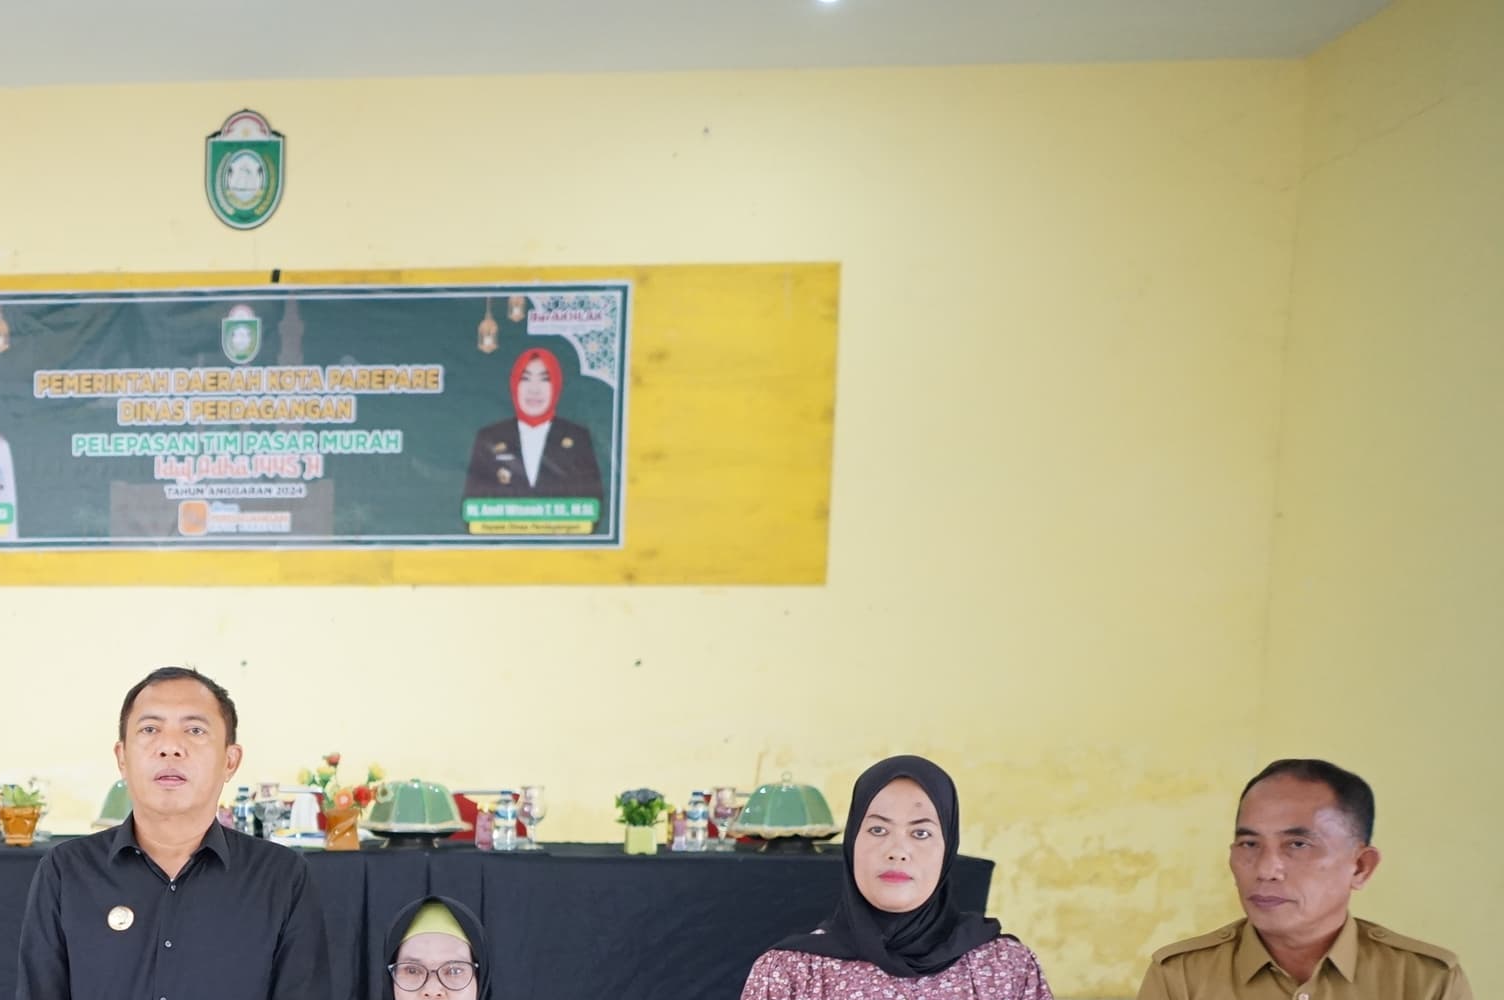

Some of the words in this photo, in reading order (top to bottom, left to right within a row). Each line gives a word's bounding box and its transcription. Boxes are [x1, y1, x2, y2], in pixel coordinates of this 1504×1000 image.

[37, 371, 170, 395] PEMERINTAH
[174, 369, 262, 393] DAERAH
[267, 368, 323, 391] KOTA
[327, 367, 441, 391] PAREPARE
[120, 400, 185, 421] DINAS
[189, 398, 353, 421] PERDAGANGAN
[73, 434, 197, 454] PELEPASAN
[202, 434, 241, 453] TIM
[245, 433, 315, 452] PASAR
[320, 432, 401, 451] MURAH
[197, 455, 250, 478] Adha
[166, 486, 204, 497] TAHUN
[207, 486, 273, 496] ANGGARAN
[275, 486, 304, 496] 2024
